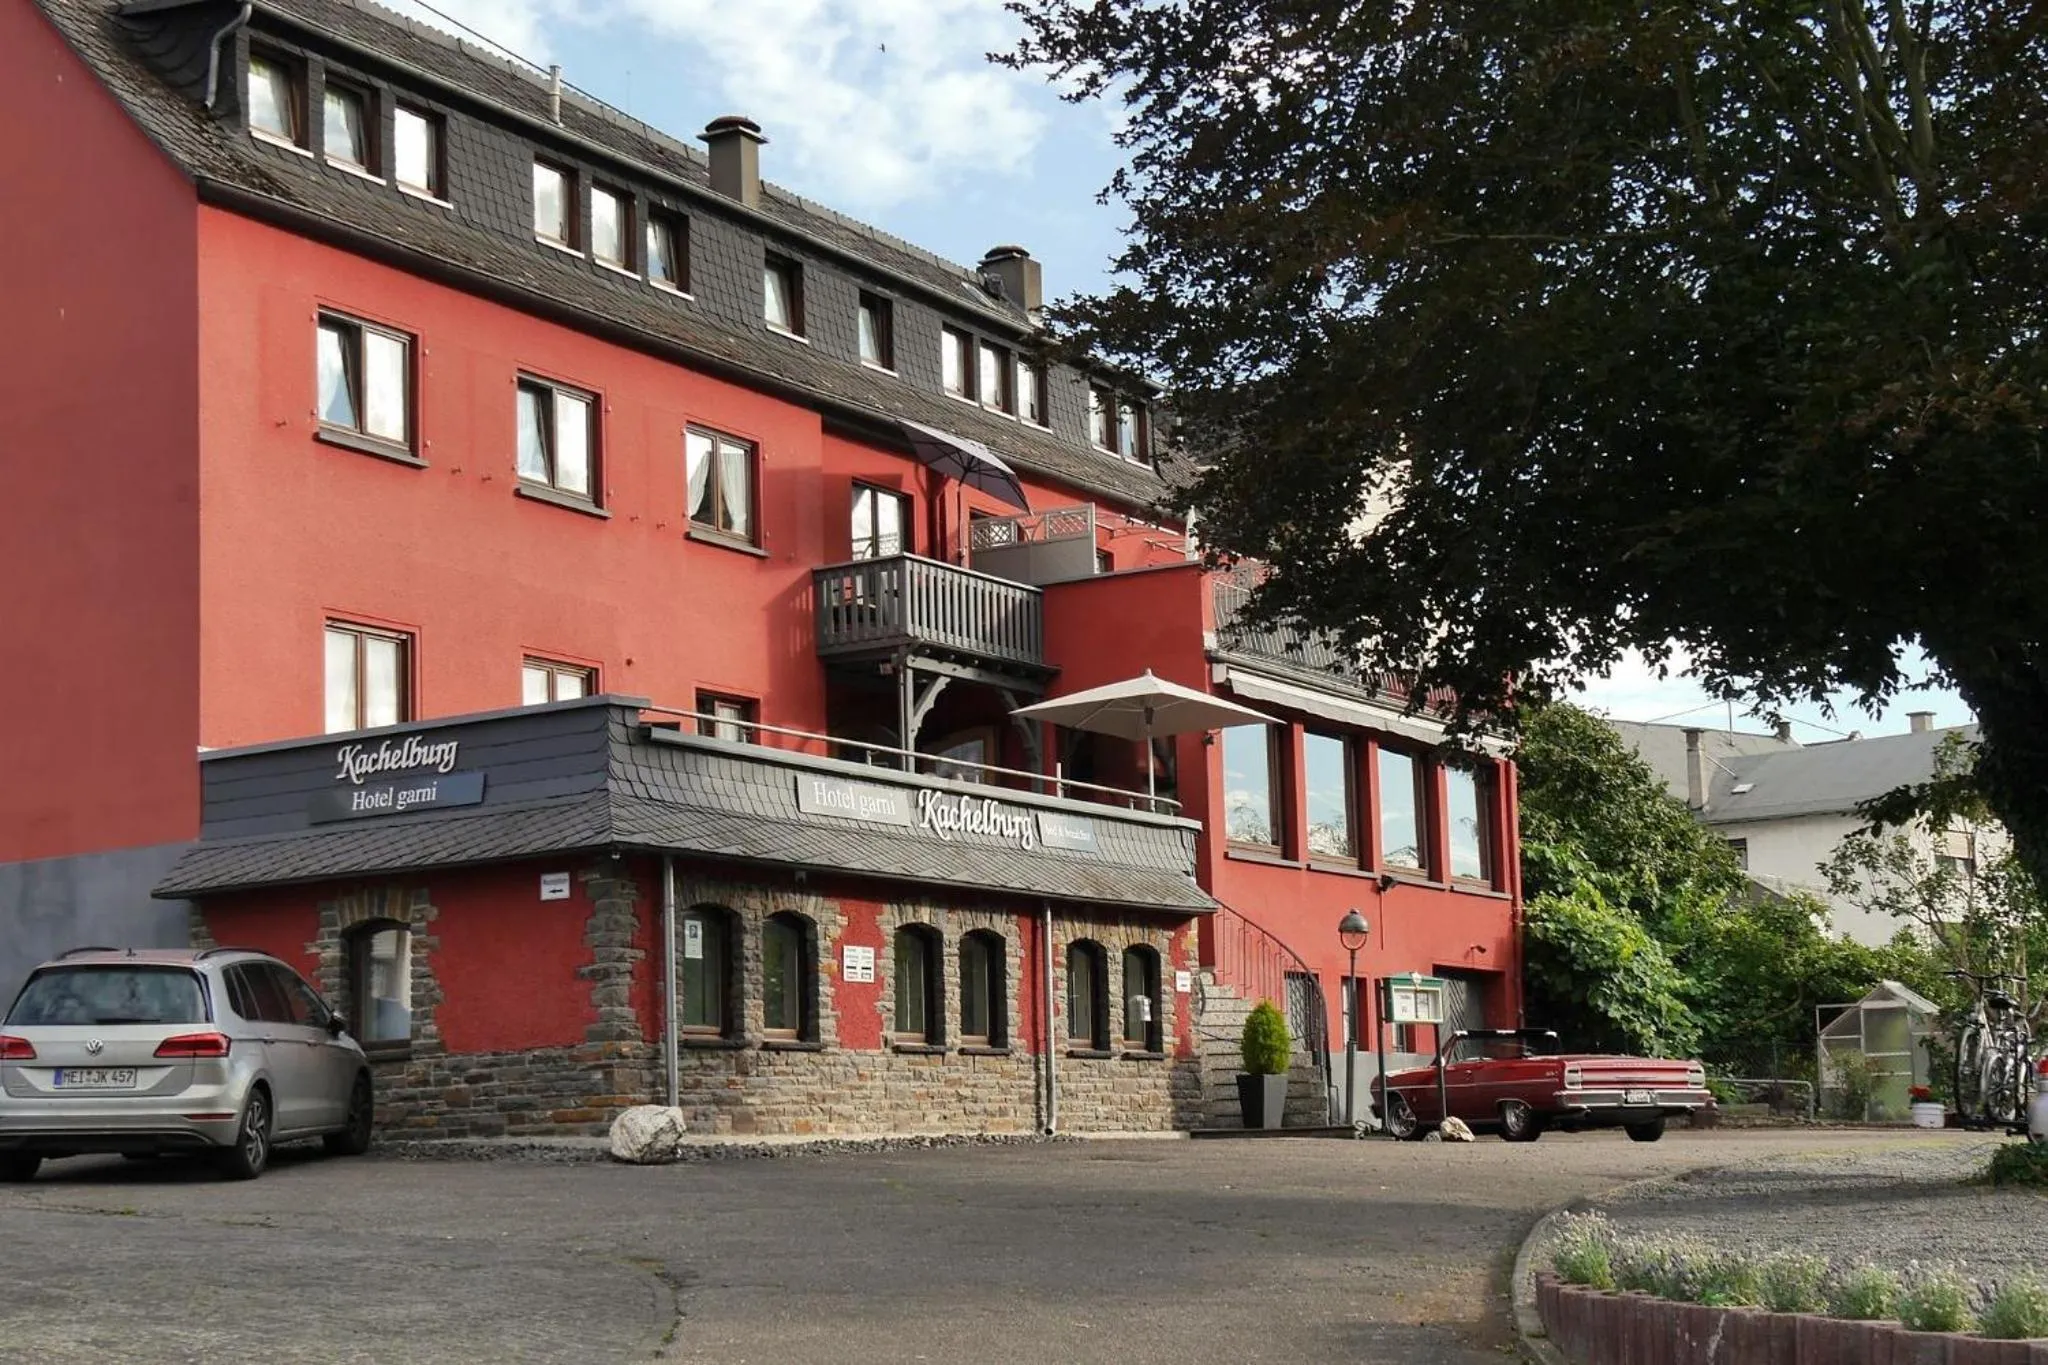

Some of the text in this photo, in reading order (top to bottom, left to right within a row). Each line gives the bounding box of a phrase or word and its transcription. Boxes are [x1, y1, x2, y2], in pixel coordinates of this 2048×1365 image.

[335, 735, 458, 785] Kachelburg
[351, 781, 438, 811] Hotel garni
[813, 781, 897, 817] Hotel garni
[918, 788, 1034, 850] Kachelburg
[92, 1071, 108, 1084] JK
[111, 1070, 133, 1083] 457
